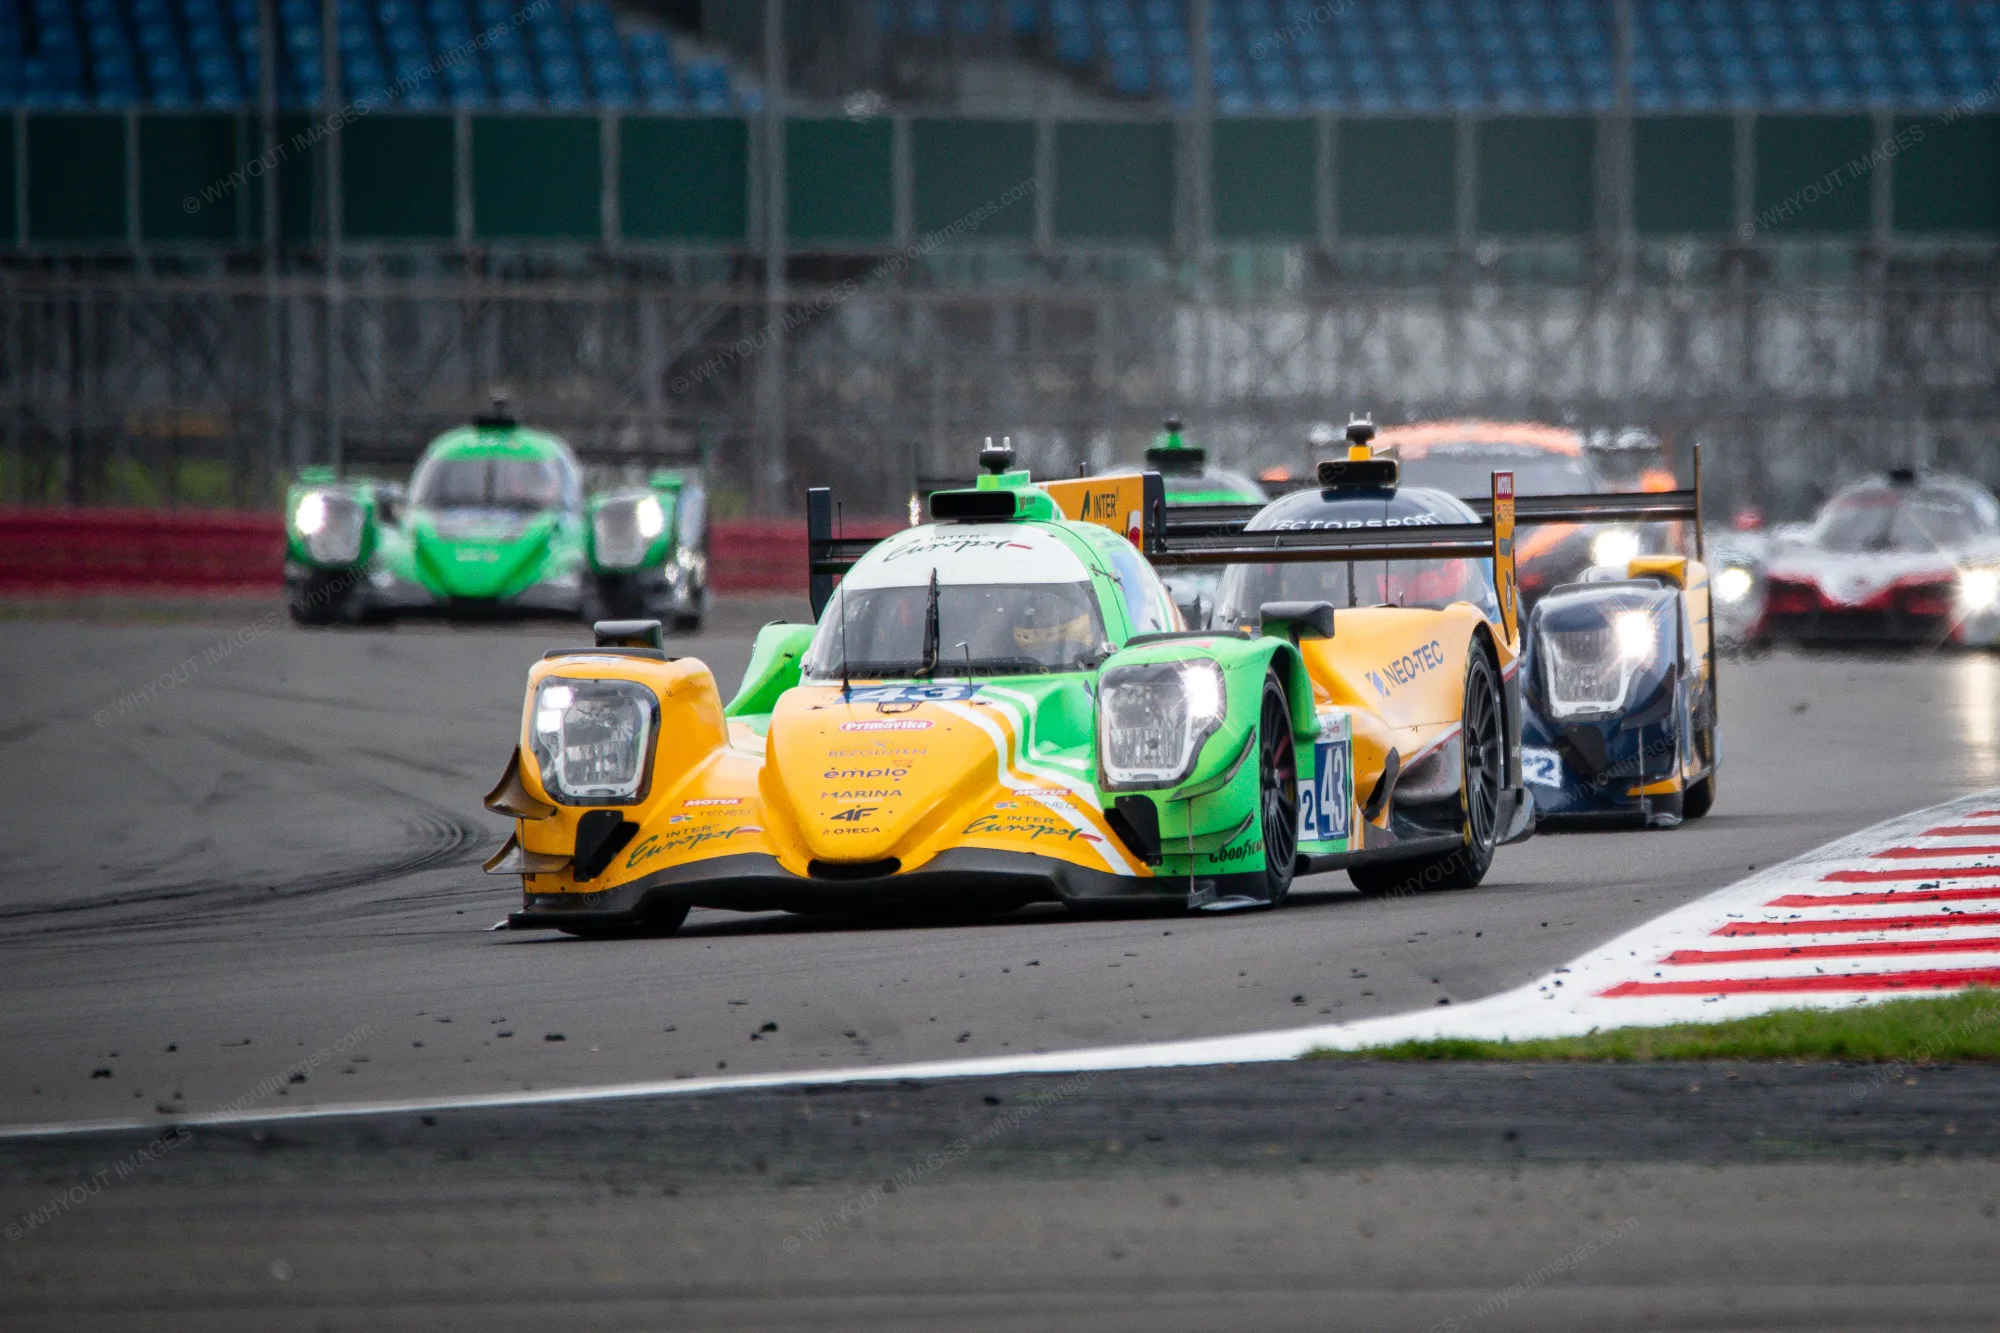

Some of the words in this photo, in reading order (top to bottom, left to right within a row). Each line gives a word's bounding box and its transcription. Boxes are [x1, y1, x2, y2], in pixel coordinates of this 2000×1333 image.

[1094, 494, 1116, 519] INTER
[1382, 640, 1444, 689] NEO-TEC
[852, 686, 965, 701] 43
[821, 790, 902, 799] MARINA
[1321, 747, 1346, 832] 43
[830, 807, 879, 821] 4F
[1007, 816, 1054, 824] INTER
[666, 825, 712, 838] INTER
